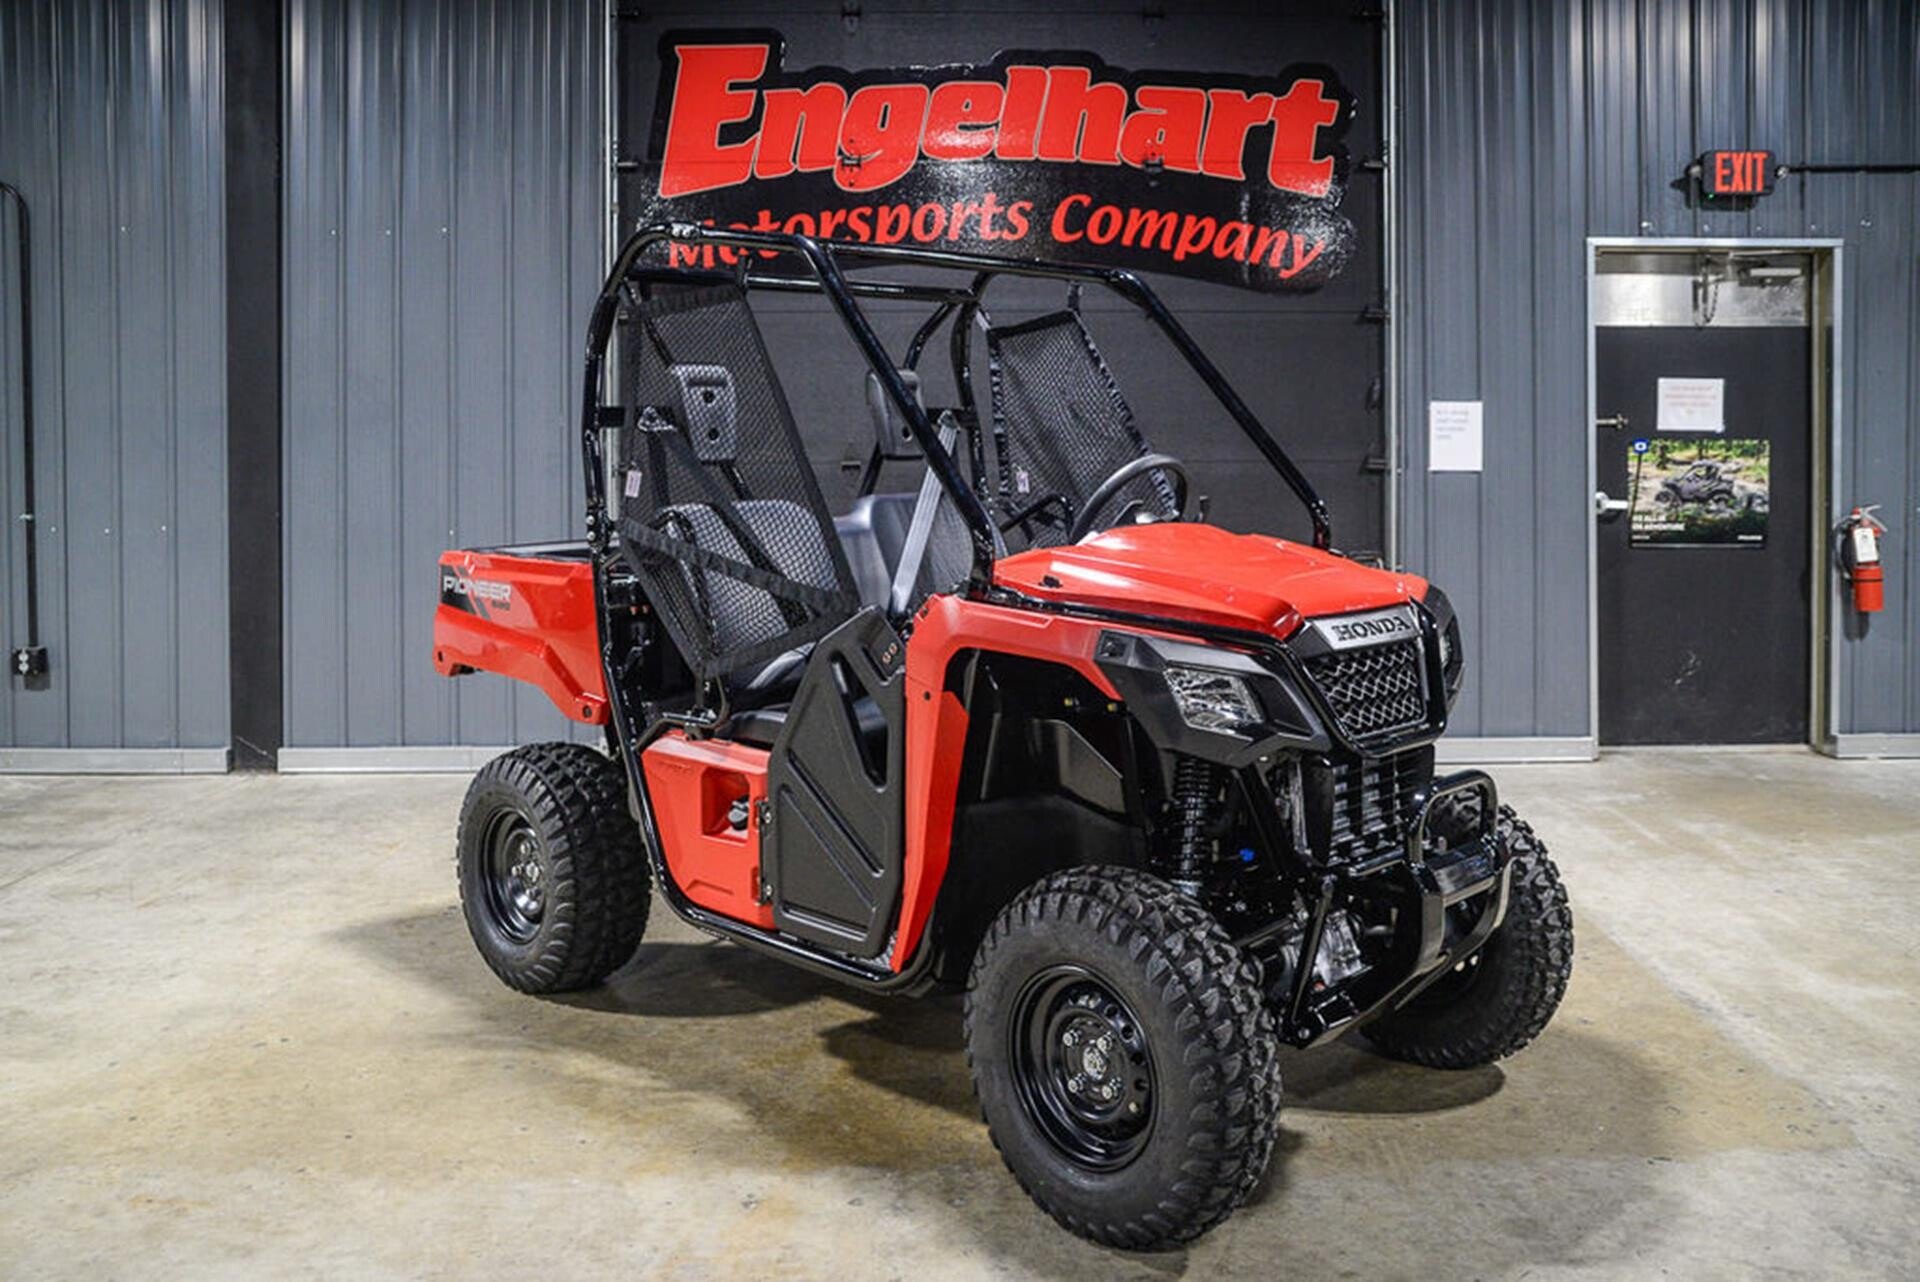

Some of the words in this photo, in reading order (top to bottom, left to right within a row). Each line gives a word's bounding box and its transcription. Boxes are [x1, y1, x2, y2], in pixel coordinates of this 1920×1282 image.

[659, 44, 1339, 199] Engelhart
[1715, 151, 1768, 193] EXIT
[1051, 193, 1326, 279] Company
[1331, 616, 1410, 641] HONDA
